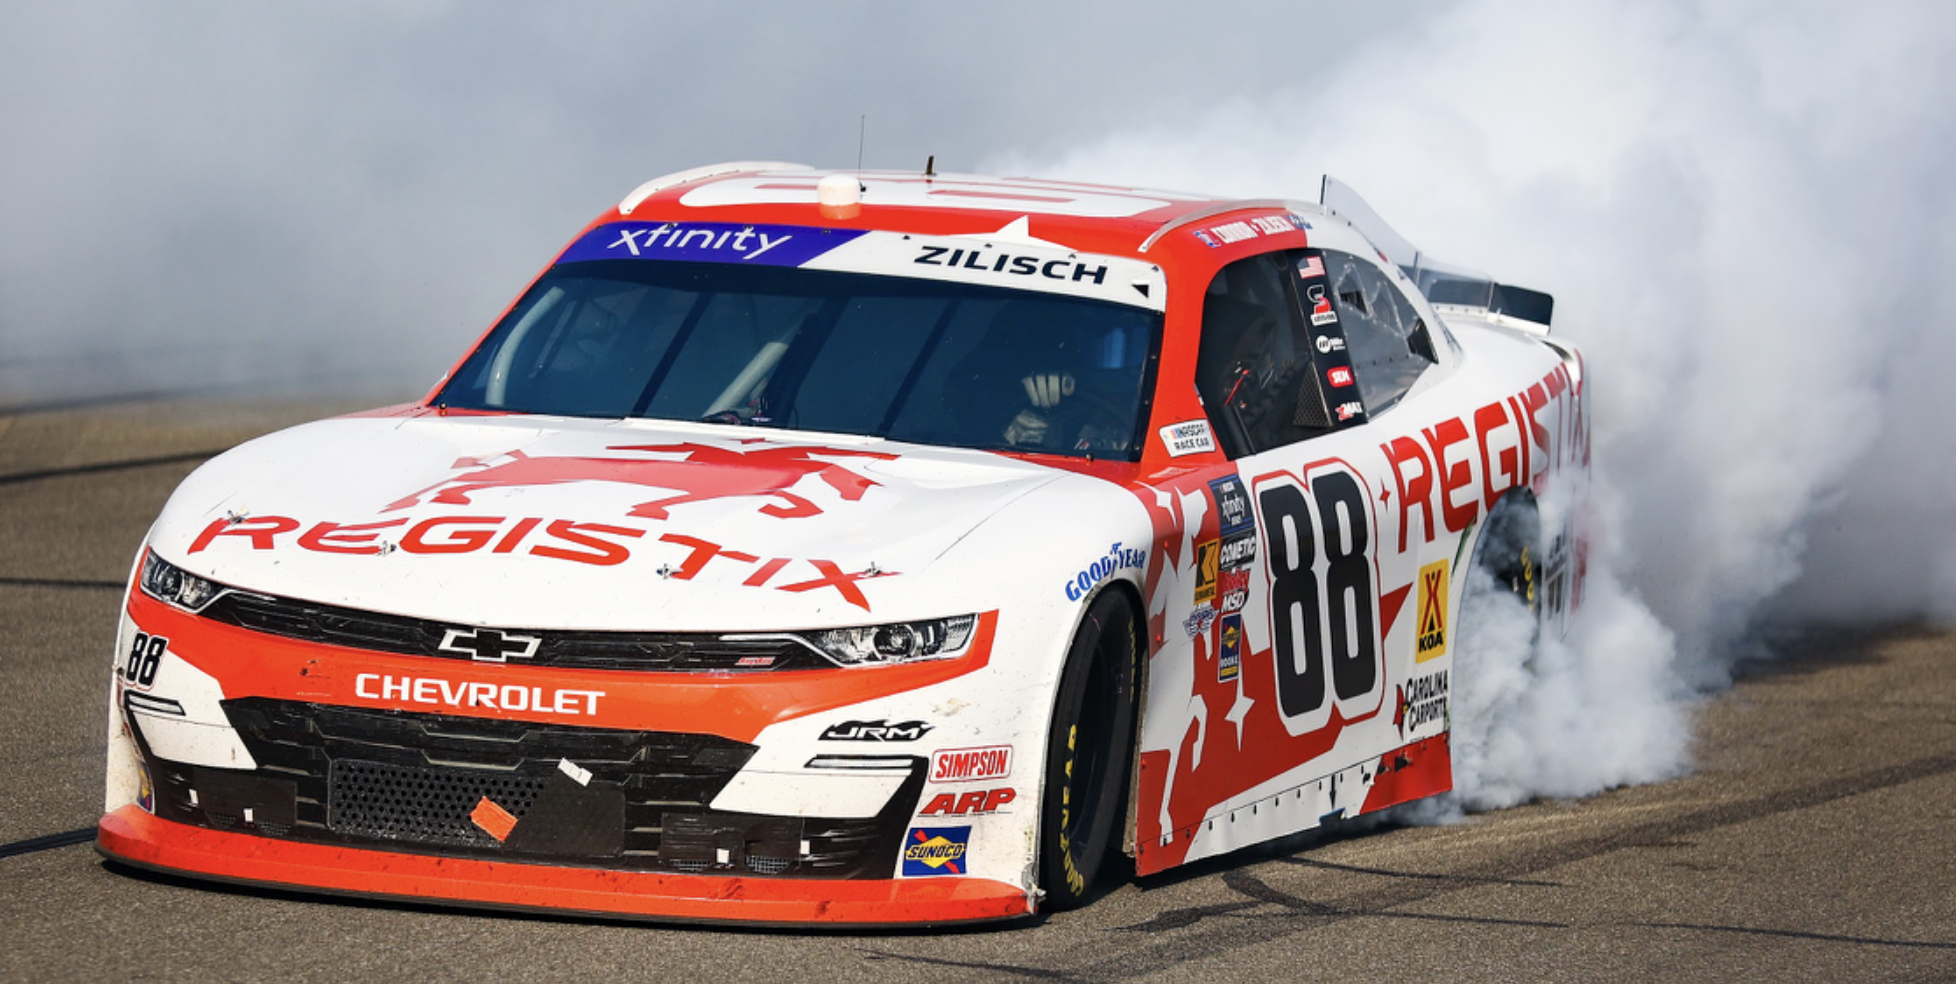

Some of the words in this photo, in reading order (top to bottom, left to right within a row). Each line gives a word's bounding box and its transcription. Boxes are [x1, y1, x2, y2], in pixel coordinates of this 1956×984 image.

[608, 223, 793, 259] xfinity
[914, 245, 1108, 285] ZILISCH
[187, 513, 903, 613] REGISTIX
[1259, 470, 1377, 718] 88
[126, 632, 168, 686] 88
[1418, 631, 1444, 653] KOA
[355, 672, 606, 716] CHEVROLET
[1405, 669, 1449, 706] CAROLINA
[826, 725, 922, 742] JRM
[936, 749, 1009, 779] SIMPSON
[919, 787, 1017, 815] ARP
[907, 844, 967, 859] SUNOCO
